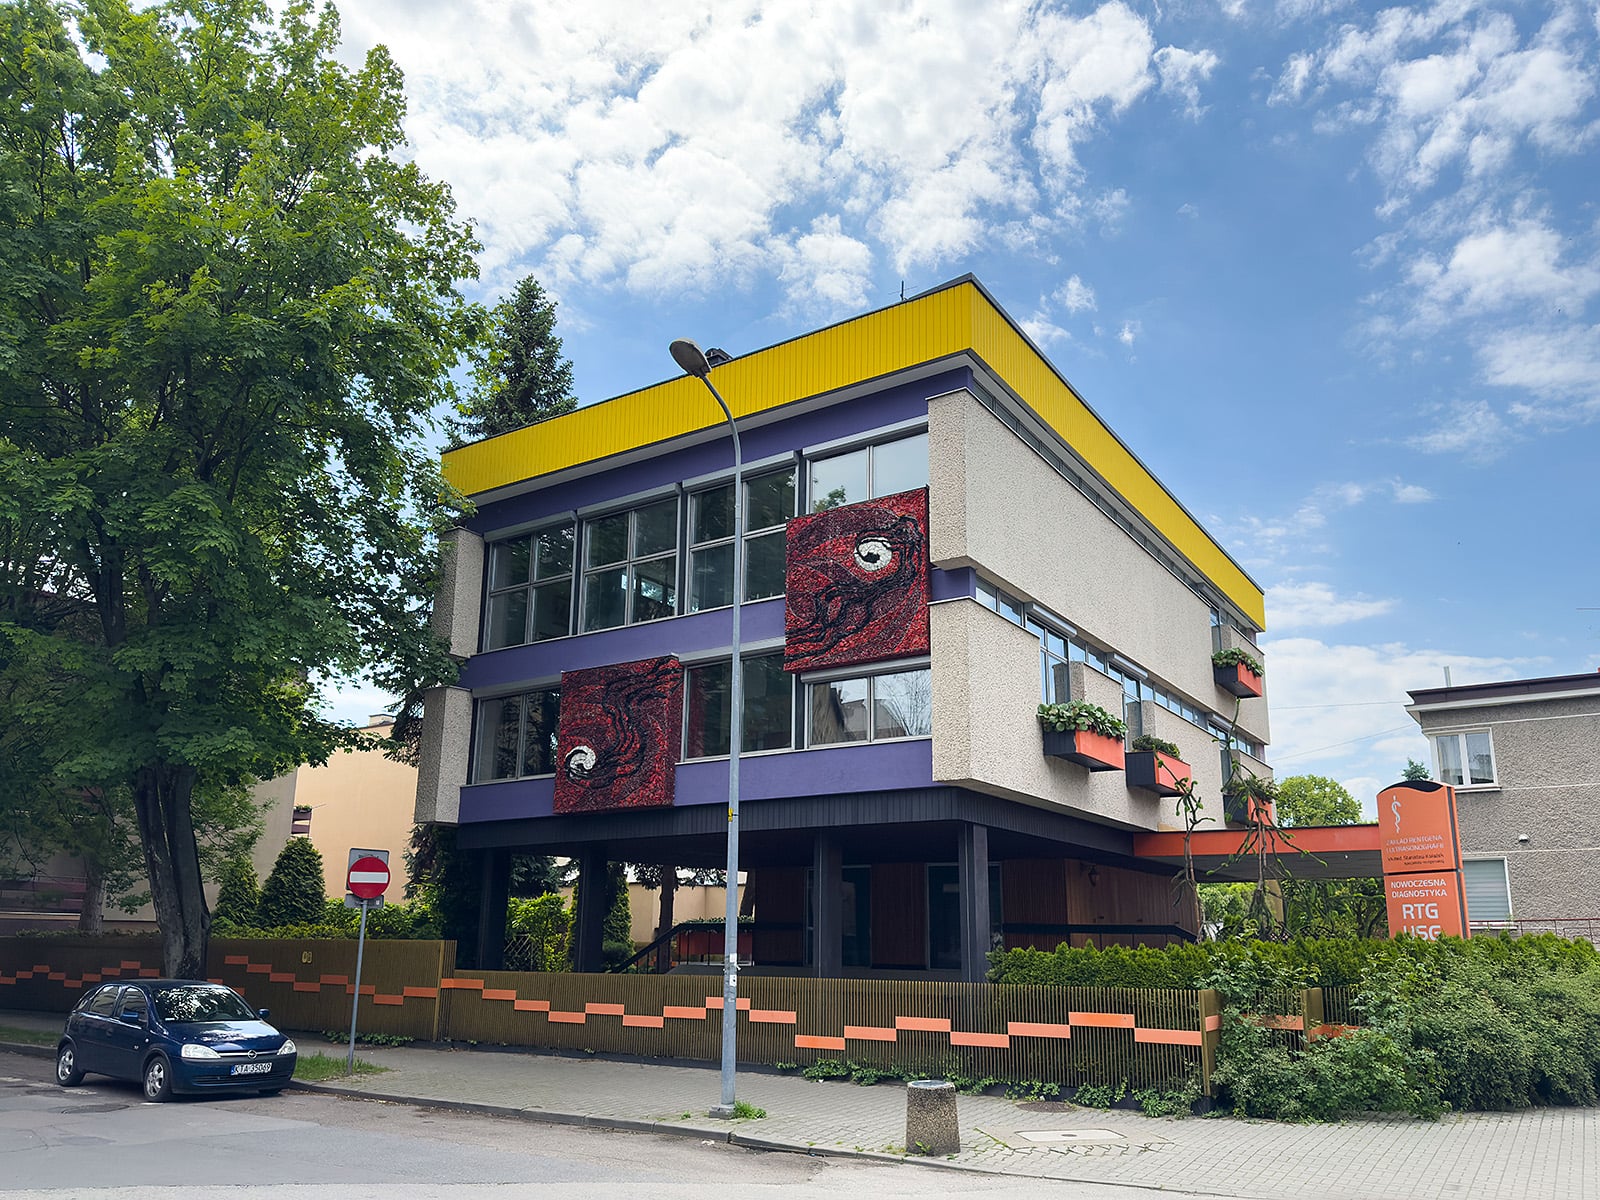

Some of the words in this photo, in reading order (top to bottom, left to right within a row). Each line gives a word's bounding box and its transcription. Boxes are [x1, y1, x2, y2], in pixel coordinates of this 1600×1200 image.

[1391, 879, 1447, 889] NOWOCZESNA
[1392, 889, 1448, 898] DIAGNOSTYKA
[1402, 902, 1439, 920] RTG
